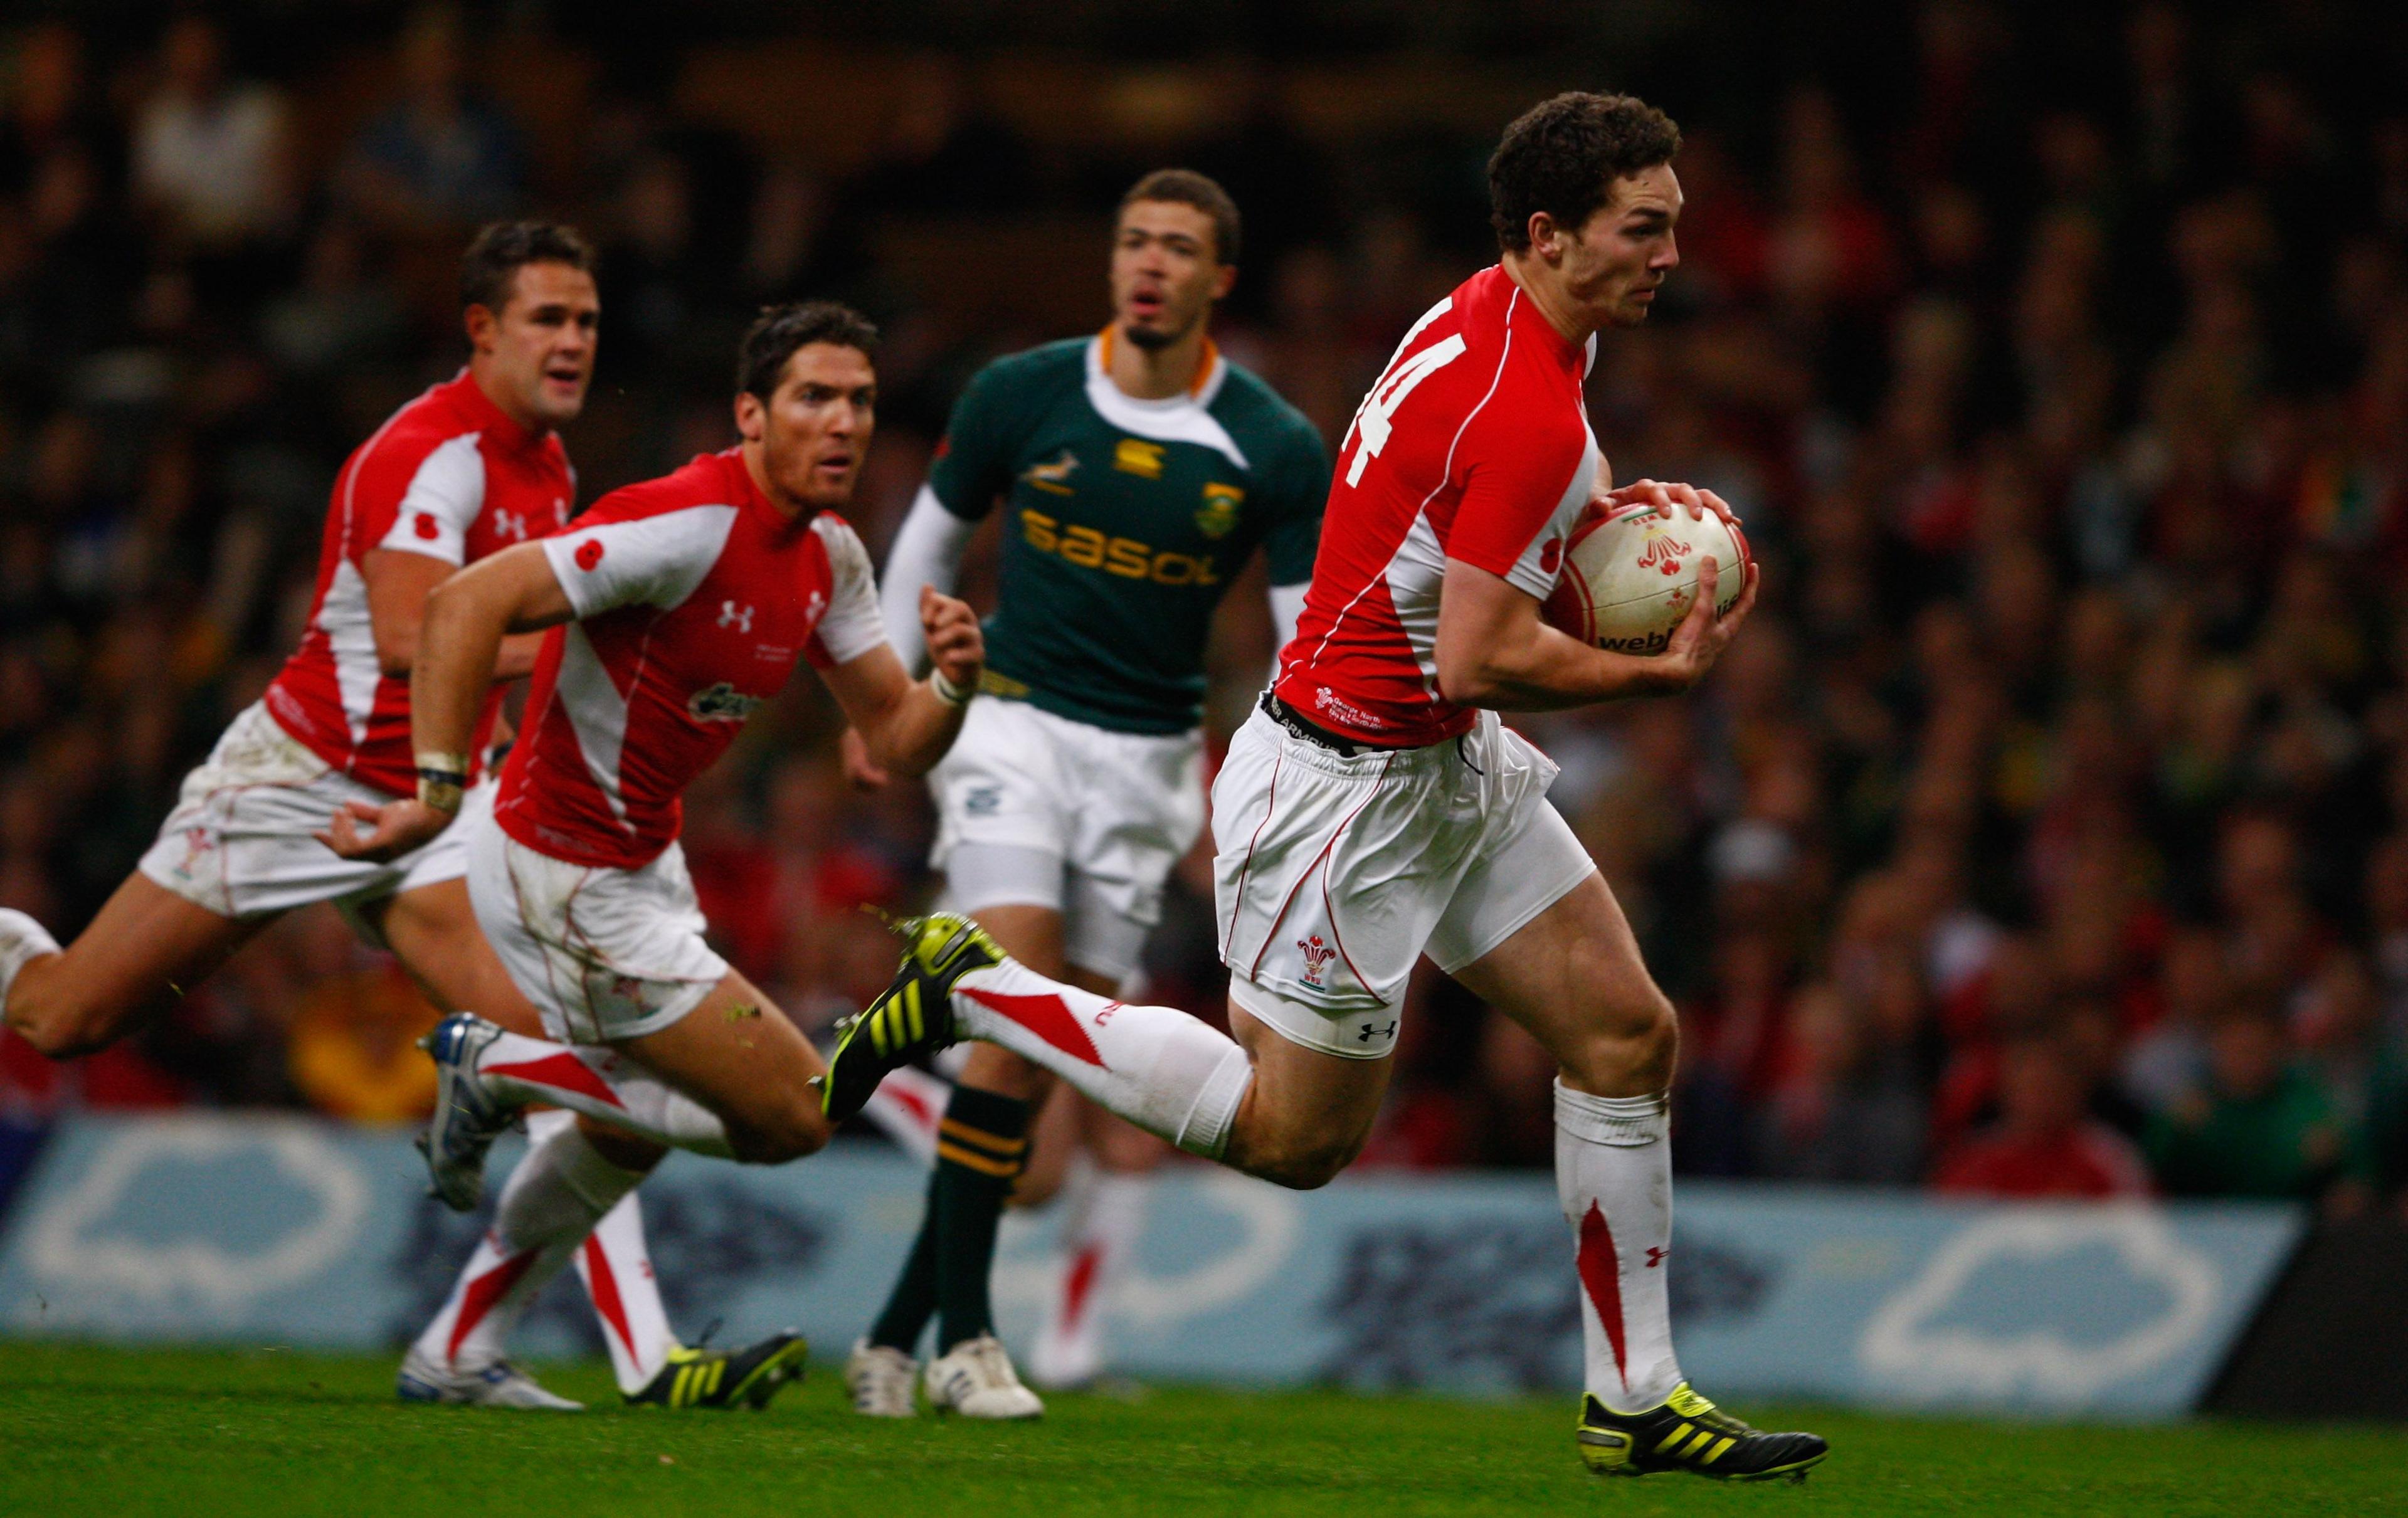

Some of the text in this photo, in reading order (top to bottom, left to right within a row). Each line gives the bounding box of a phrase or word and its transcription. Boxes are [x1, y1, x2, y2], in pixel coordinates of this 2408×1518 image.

[1021, 508, 1218, 585] sasol
[1334, 697, 1380, 724] George North
